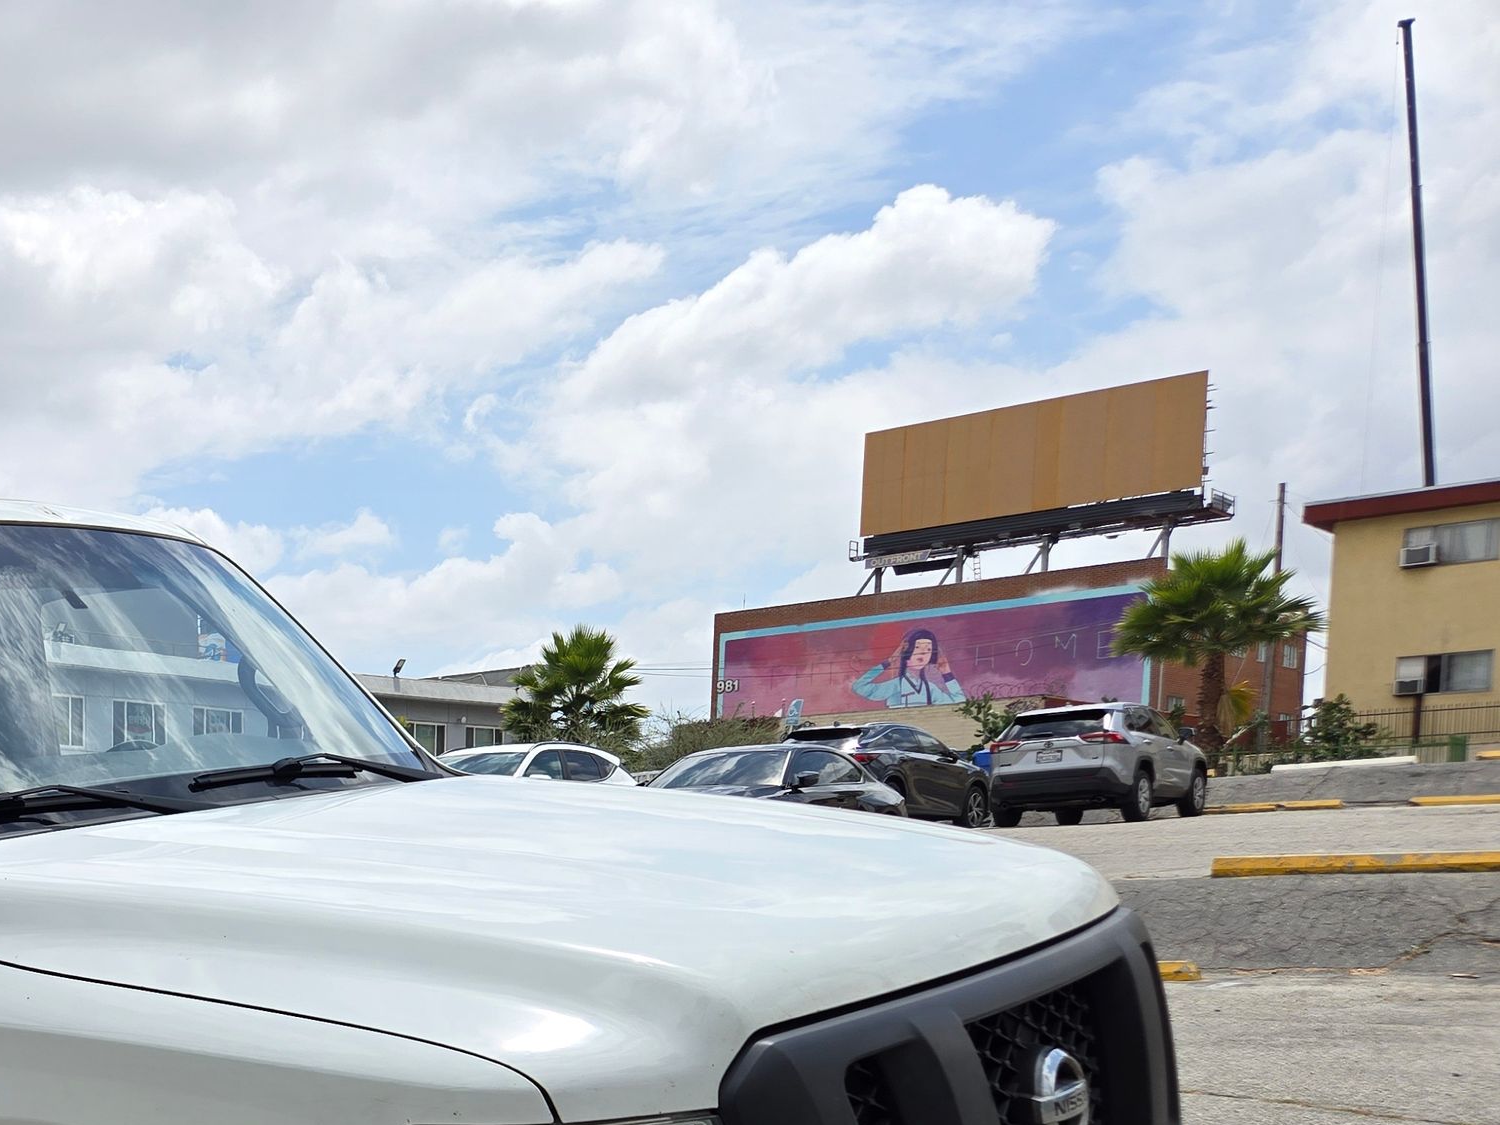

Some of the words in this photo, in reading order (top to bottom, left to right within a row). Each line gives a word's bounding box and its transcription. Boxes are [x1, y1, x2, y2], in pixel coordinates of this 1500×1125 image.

[870, 552, 923, 567] OUTFRONT
[974, 629, 1115, 668] HOME
[717, 679, 739, 694] 981
